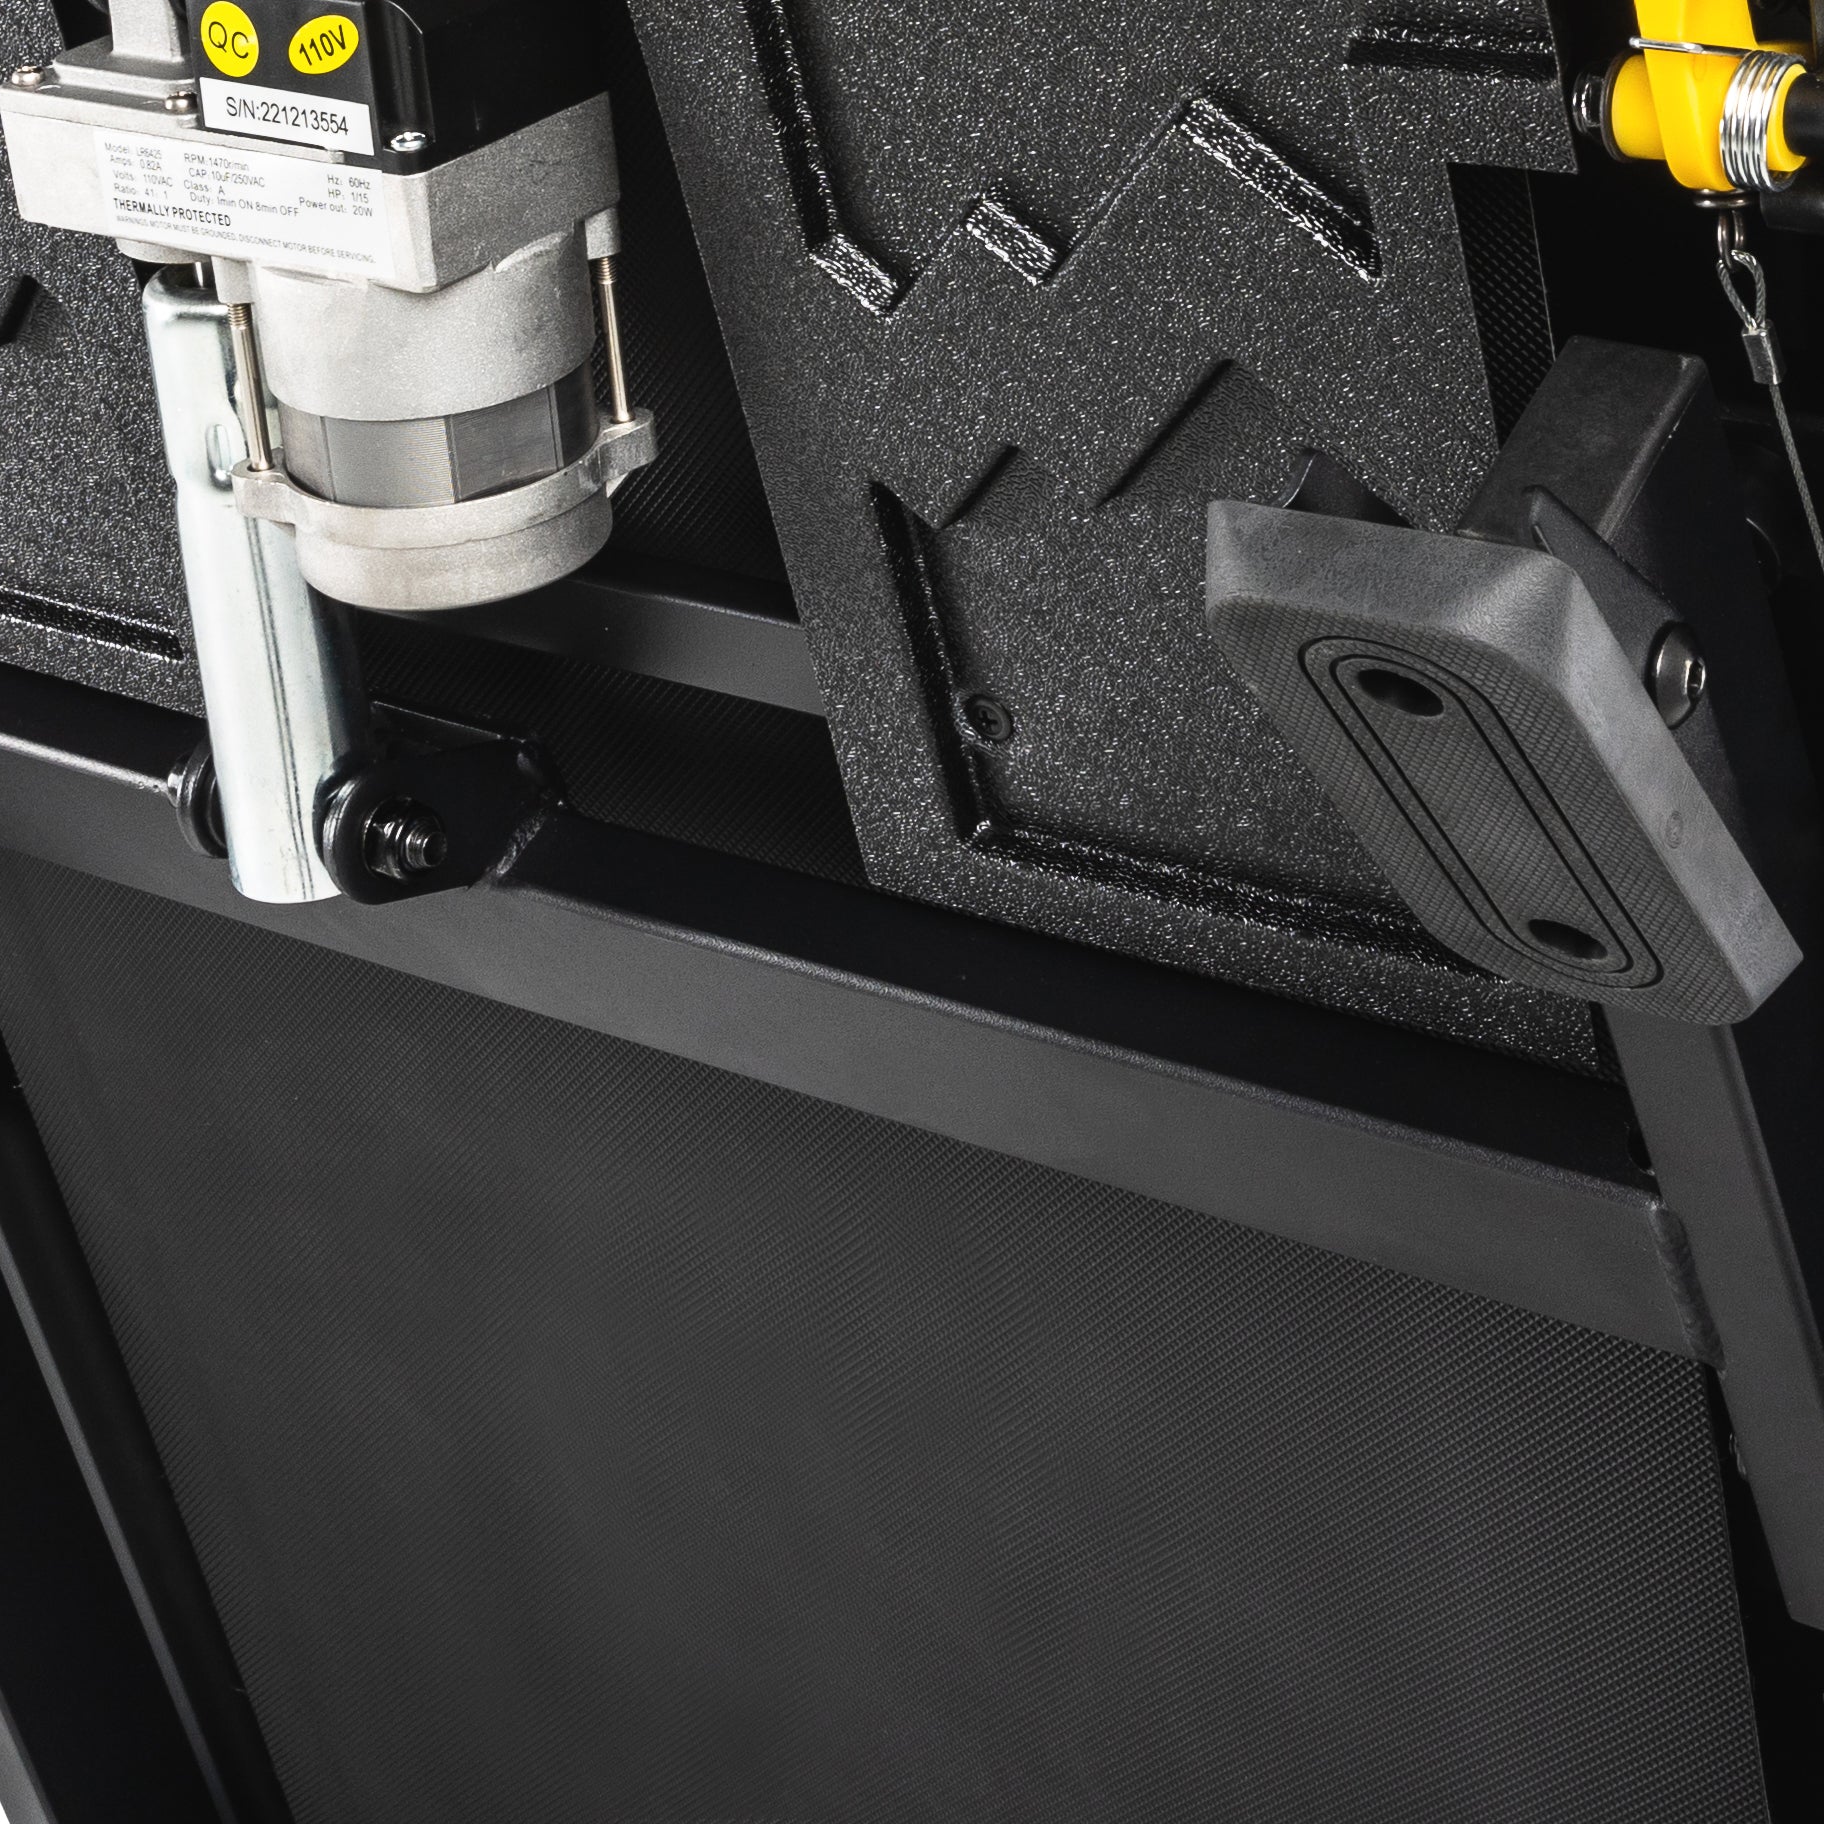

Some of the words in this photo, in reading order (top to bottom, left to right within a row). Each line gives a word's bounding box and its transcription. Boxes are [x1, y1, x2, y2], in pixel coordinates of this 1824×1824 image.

[208, 21, 249, 59] QC
[299, 24, 346, 66] 110V
[226, 96, 349, 136] S/N:221213554
[143, 173, 173, 188] 110VAC
[218, 185, 225, 195] A
[348, 176, 371, 190] 60Hz
[238, 198, 253, 210] ON
[255, 201, 277, 214] 8min
[279, 205, 300, 217] OFF
[298, 196, 327, 210] Power
[352, 204, 373, 217] 20W
[351, 191, 369, 204] 1/15
[113, 197, 170, 218] THERMALLY
[172, 206, 231, 227] PROTECTED
[238, 233, 281, 248] DISCONNECT
[282, 240, 307, 254] MOTOR
[308, 244, 335, 257] BEFORE
